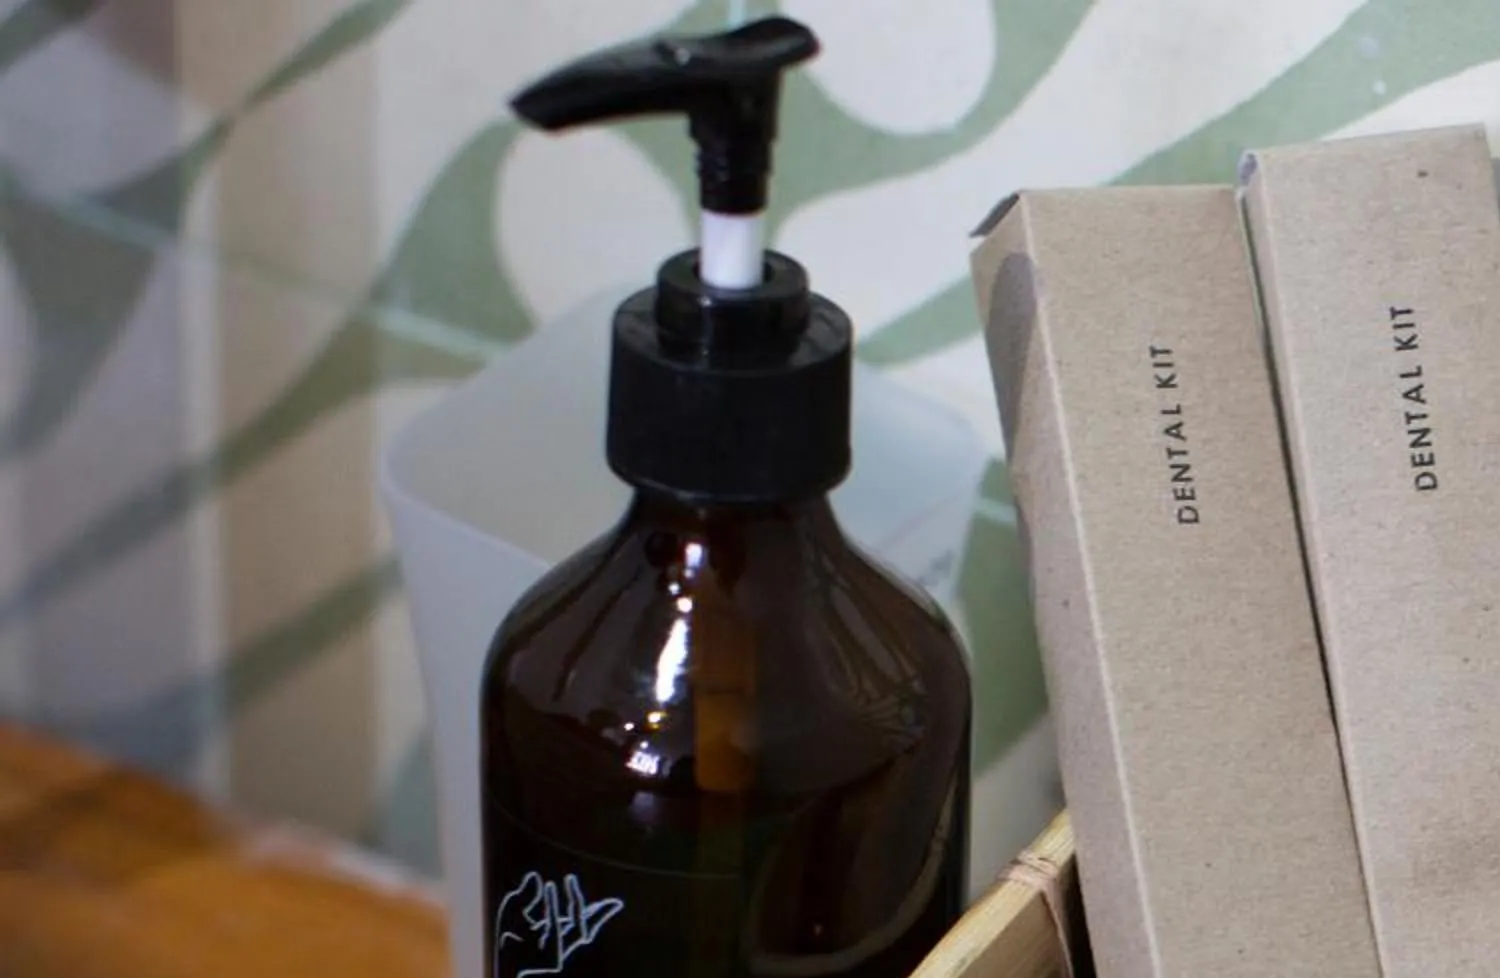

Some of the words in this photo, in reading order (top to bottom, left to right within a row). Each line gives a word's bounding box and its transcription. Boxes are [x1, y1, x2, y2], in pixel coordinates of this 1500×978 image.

[1150, 346, 1179, 389] KIT
[1390, 306, 1420, 351] KIT
[1161, 403, 1199, 524] DENTAL
[1400, 366, 1438, 491] DENTAL
